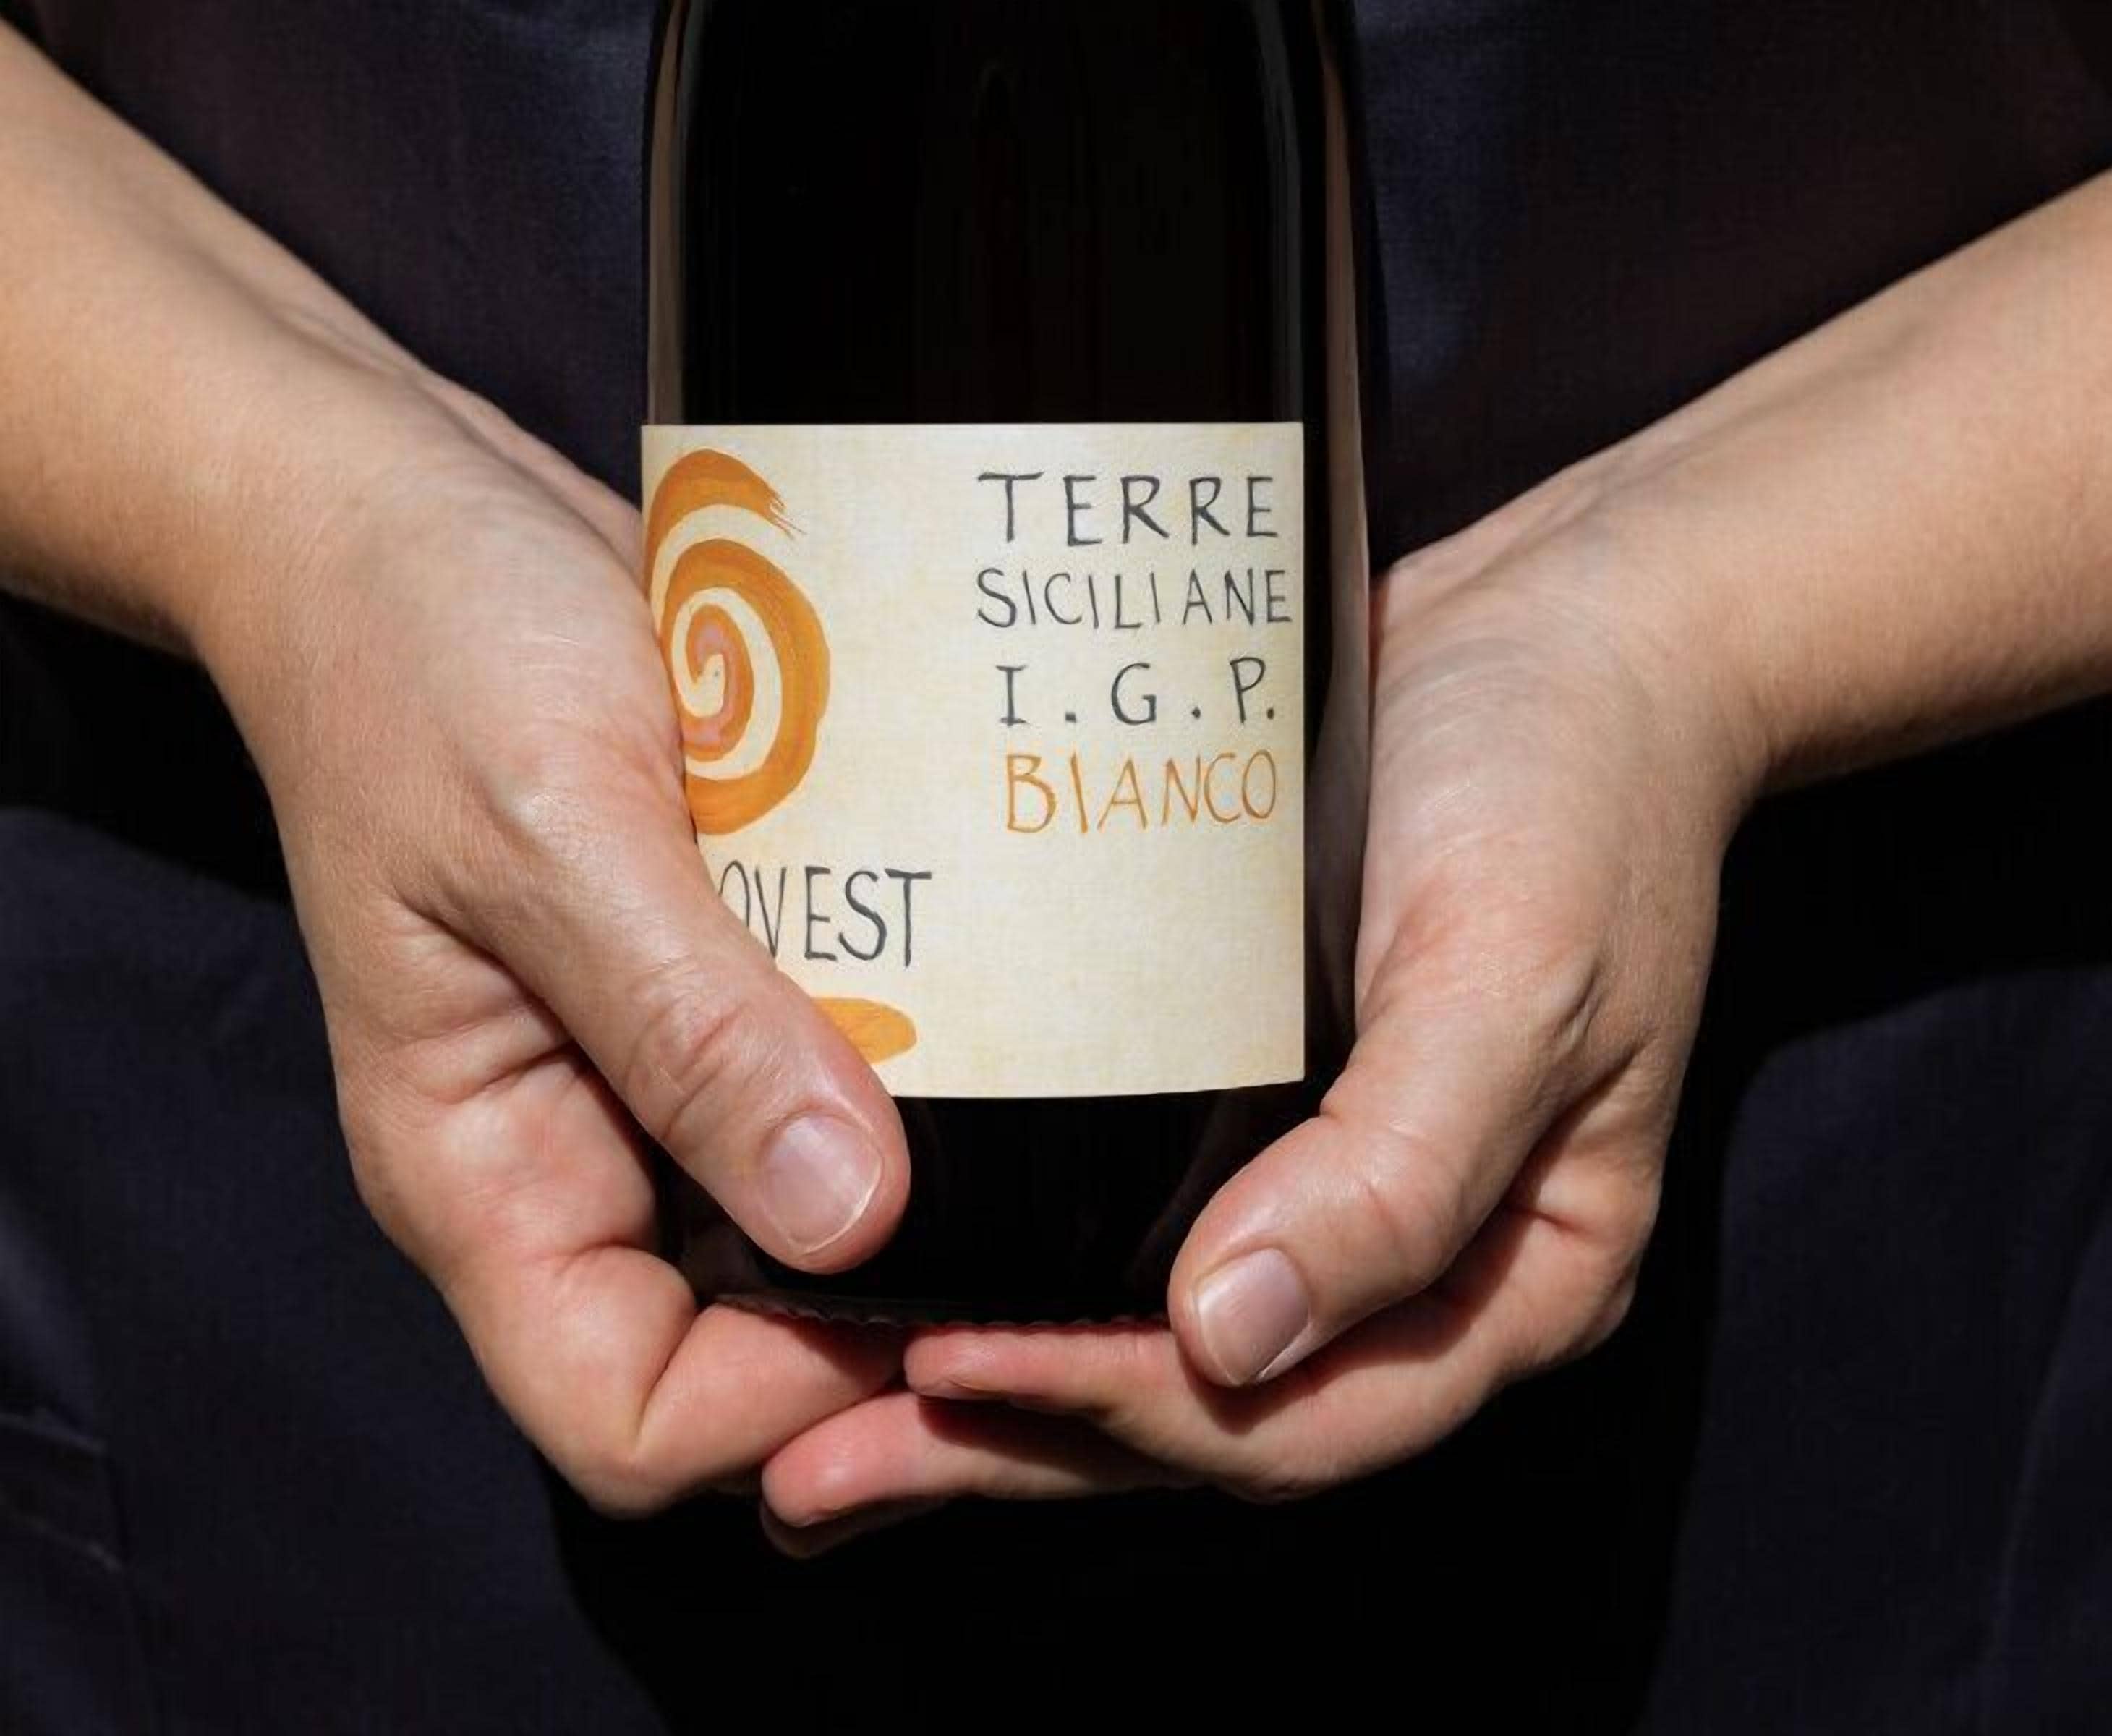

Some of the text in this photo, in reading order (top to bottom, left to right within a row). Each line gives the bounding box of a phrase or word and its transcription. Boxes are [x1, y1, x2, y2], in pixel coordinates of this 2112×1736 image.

[977, 472, 1279, 546] TERRE
[977, 568, 1293, 629] SICILIANE
[1005, 749, 1277, 834] BIANCO
